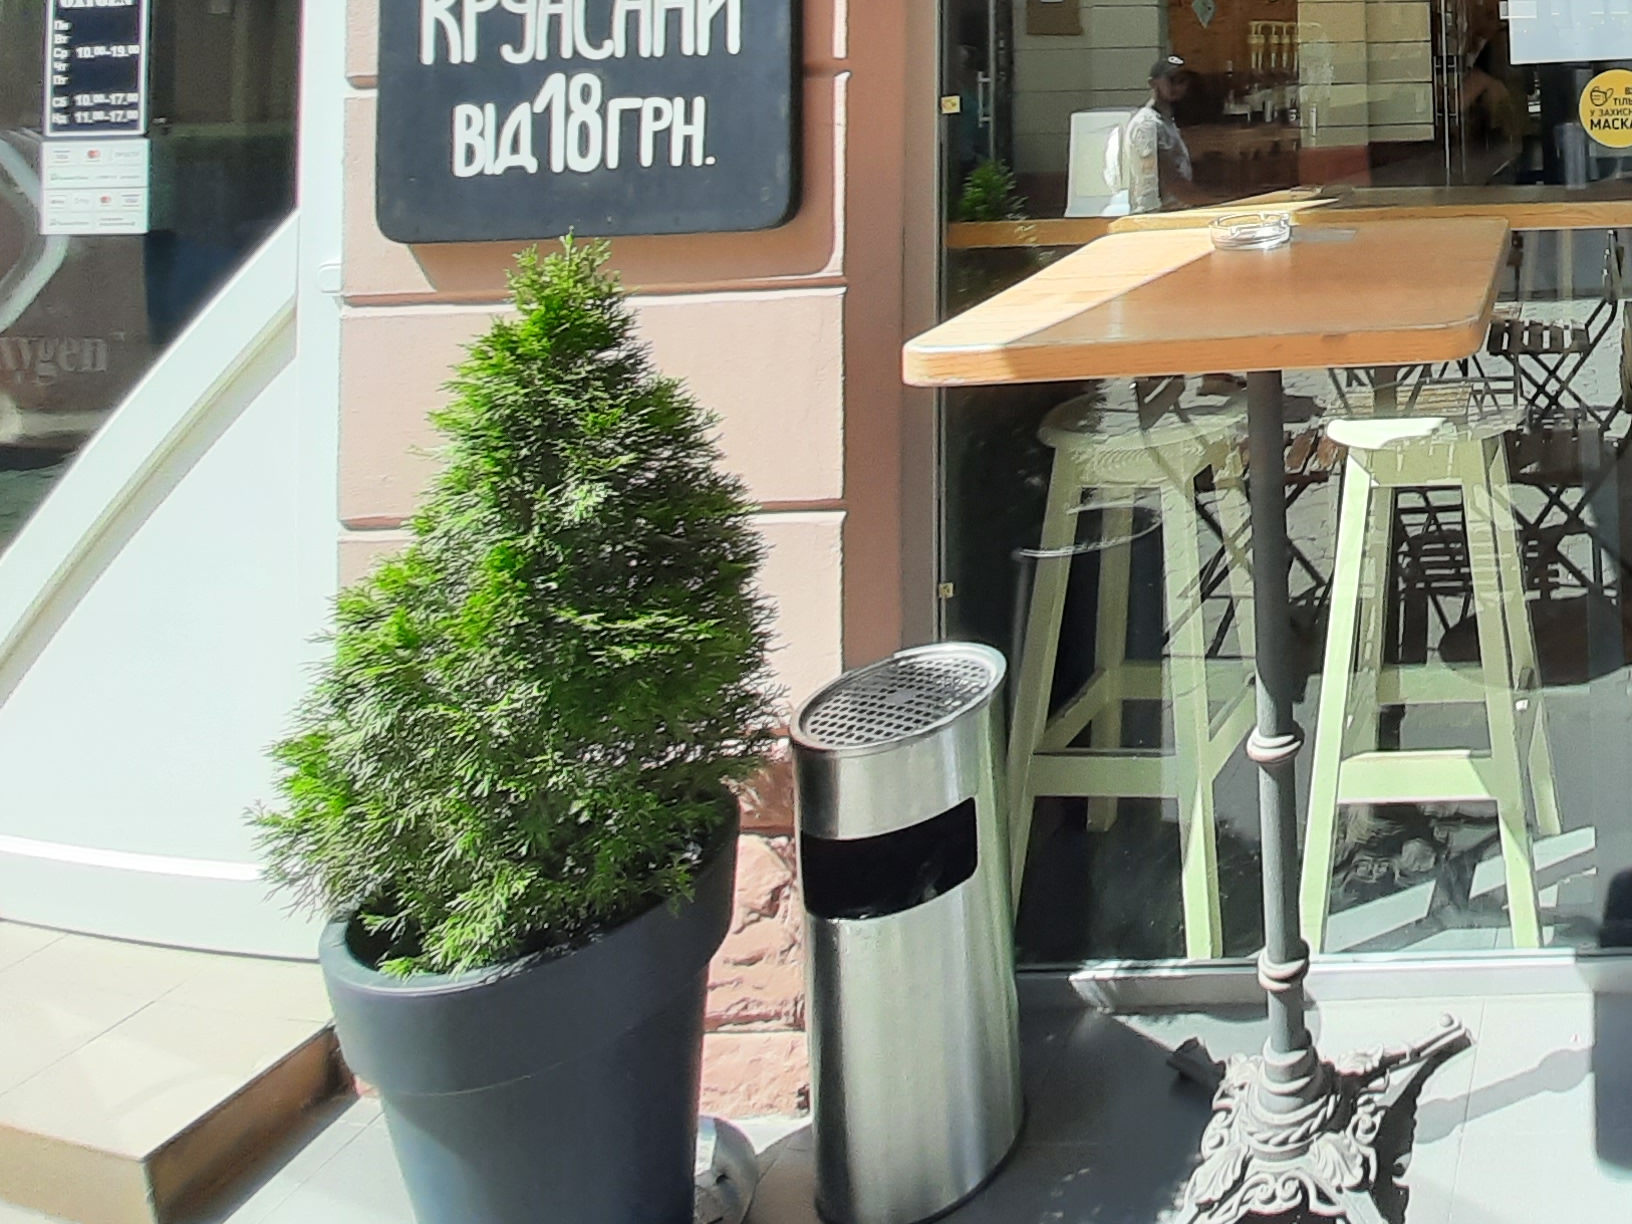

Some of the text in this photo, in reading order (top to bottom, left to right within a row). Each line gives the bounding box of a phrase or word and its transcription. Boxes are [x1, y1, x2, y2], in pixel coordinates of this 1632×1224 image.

[453, 72, 718, 177] ВІД 18 ГРН.
